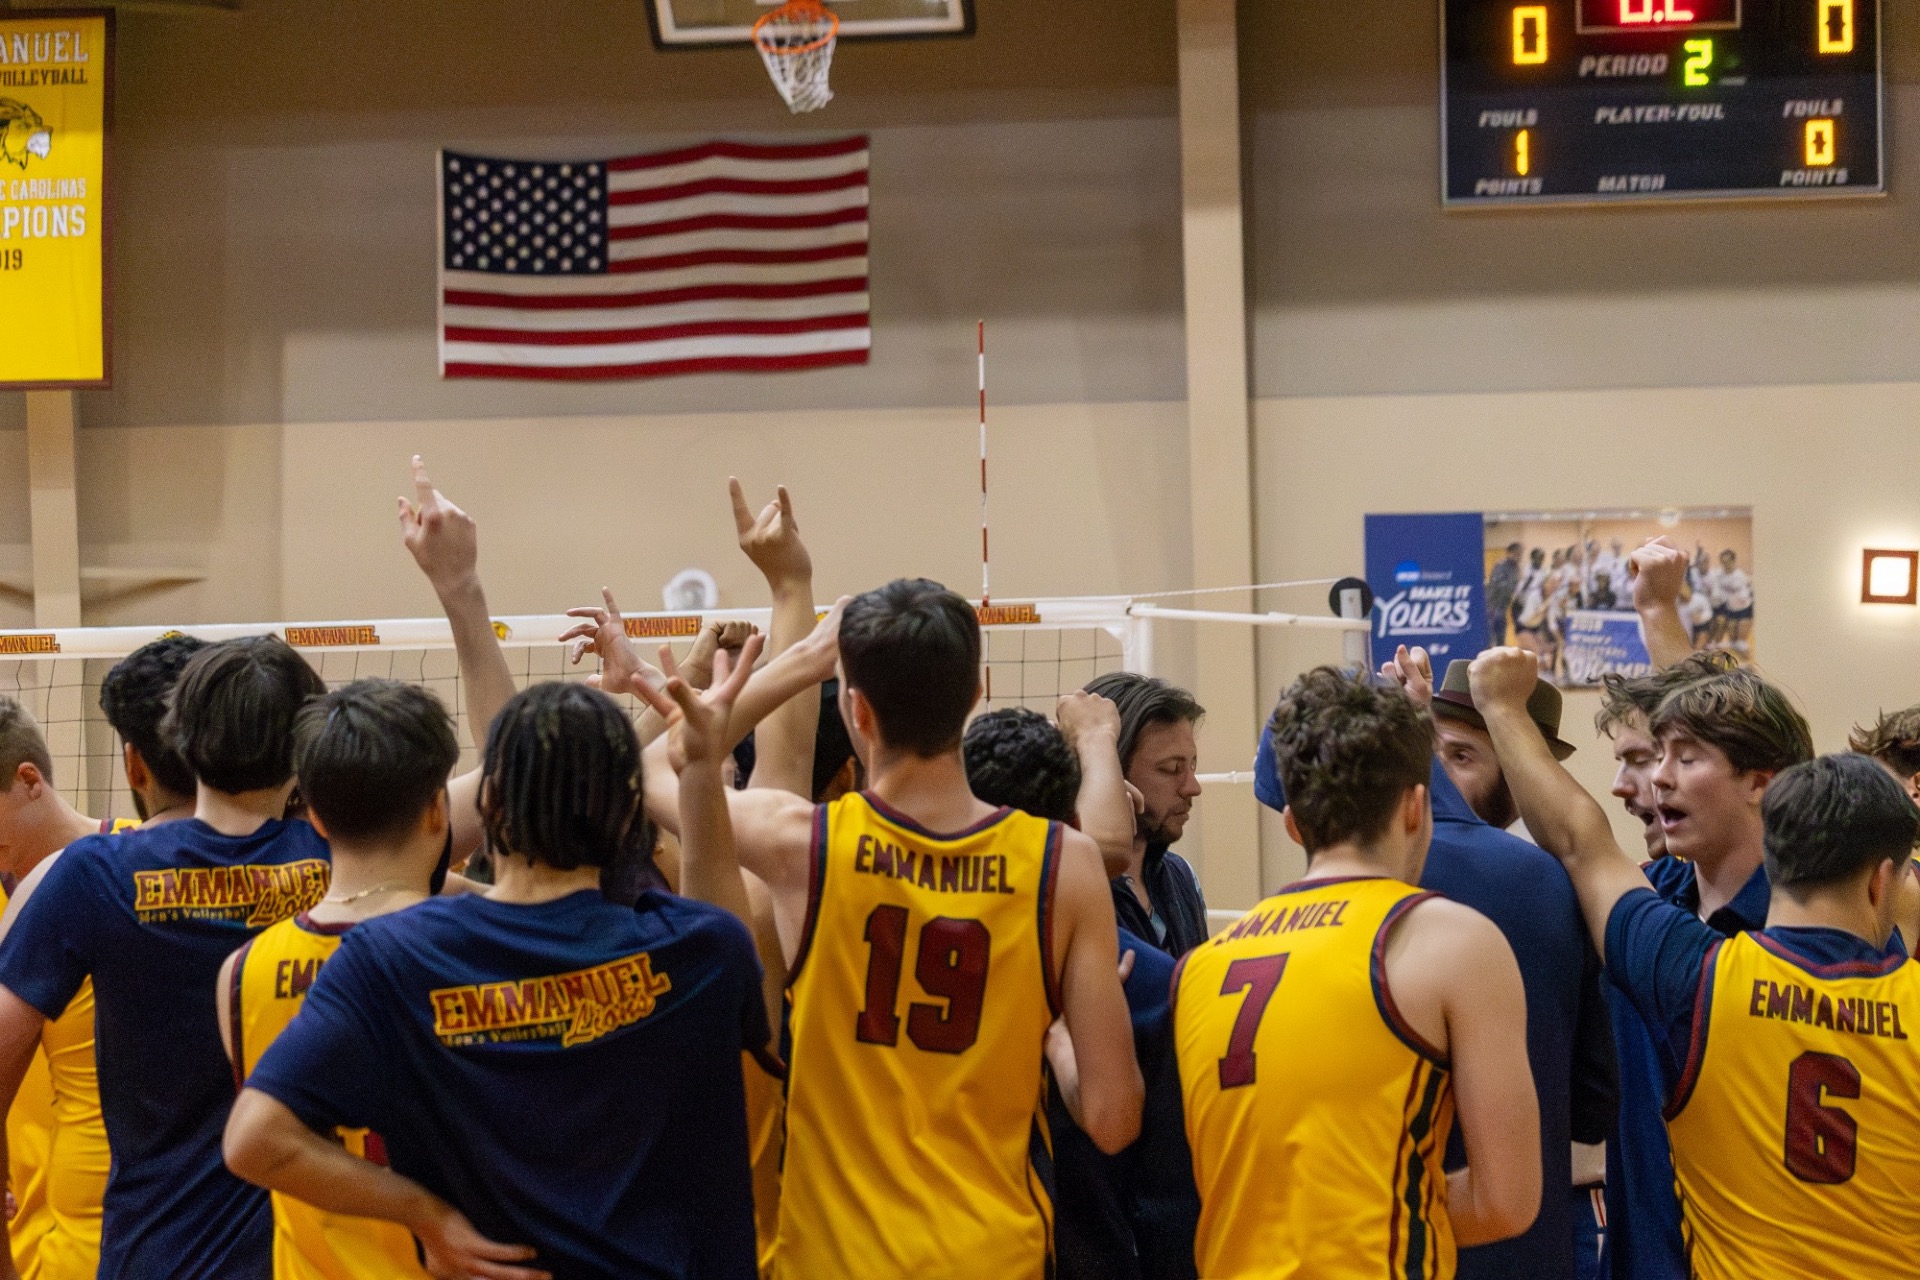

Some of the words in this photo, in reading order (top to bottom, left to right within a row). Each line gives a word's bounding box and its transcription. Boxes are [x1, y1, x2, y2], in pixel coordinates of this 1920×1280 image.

[1512, 5, 1548, 65] 0
[0, 68, 88, 87] OLLEYBALL
[1578, 53, 1669, 78] PERIOD
[1684, 39, 1713, 86] 2
[1478, 108, 1539, 128] FOULS
[1781, 99, 1844, 119] FOULS
[1515, 129, 1530, 176] 1
[1805, 118, 1835, 167] 0
[10, 177, 86, 200] CAROLINAS
[1474, 176, 1543, 196] POINTS
[1597, 173, 1667, 193] MATCH
[1780, 167, 1849, 187] POINTS
[0, 204, 86, 239] PIONS
[1373, 590, 1472, 638] YOURS
[1408, 585, 1455, 602] MAKE
[285, 626, 380, 646] EMMANUEL
[856, 834, 1015, 894] EMMANUEL
[430, 952, 672, 1036] EMMANUEL
[856, 903, 992, 1056] 19
[562, 990, 656, 1049] Lions
[1218, 952, 1291, 1091] 7
[1749, 978, 1908, 1040] EMMANUEL
[1784, 1050, 1862, 1185] 6
